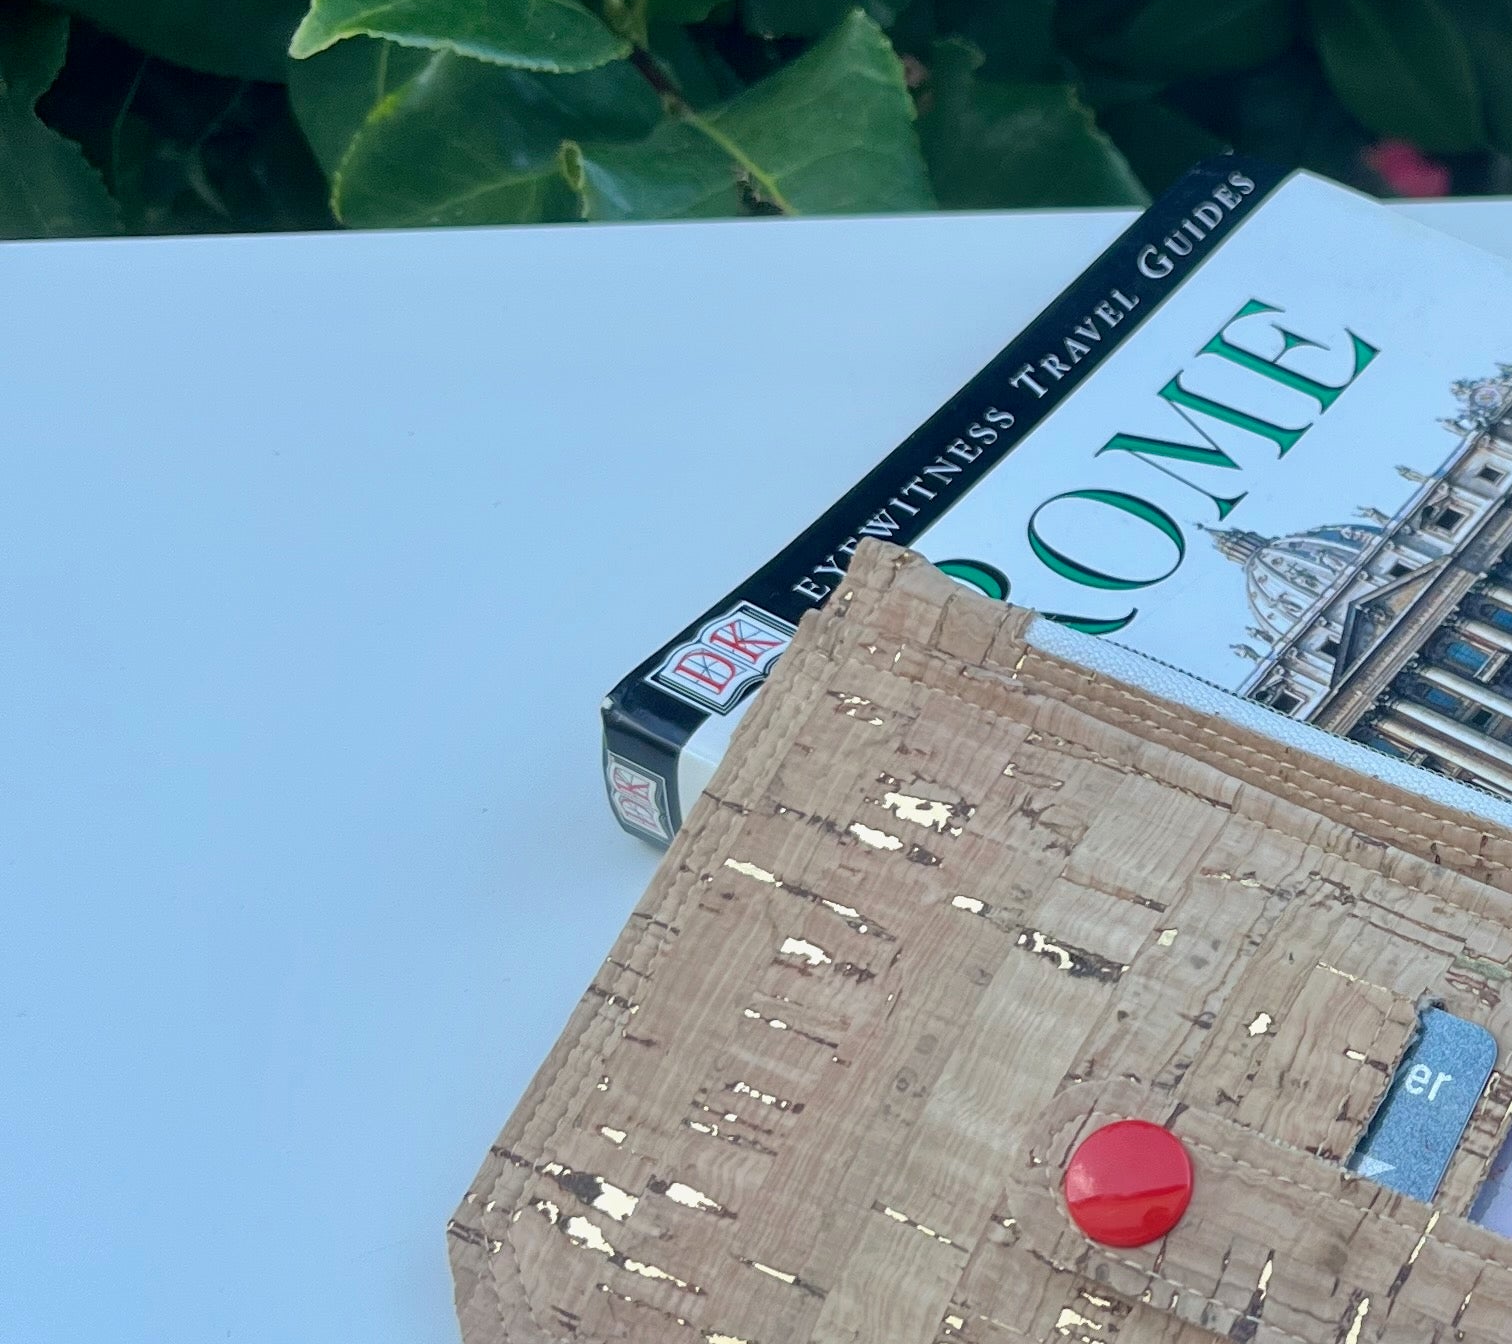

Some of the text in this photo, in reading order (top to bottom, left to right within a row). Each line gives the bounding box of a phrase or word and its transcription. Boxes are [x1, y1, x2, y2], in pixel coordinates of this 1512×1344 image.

[1008, 288, 1140, 399] TRAVEL
[1137, 170, 1256, 279] GUIDES
[673, 619, 787, 695] DK
